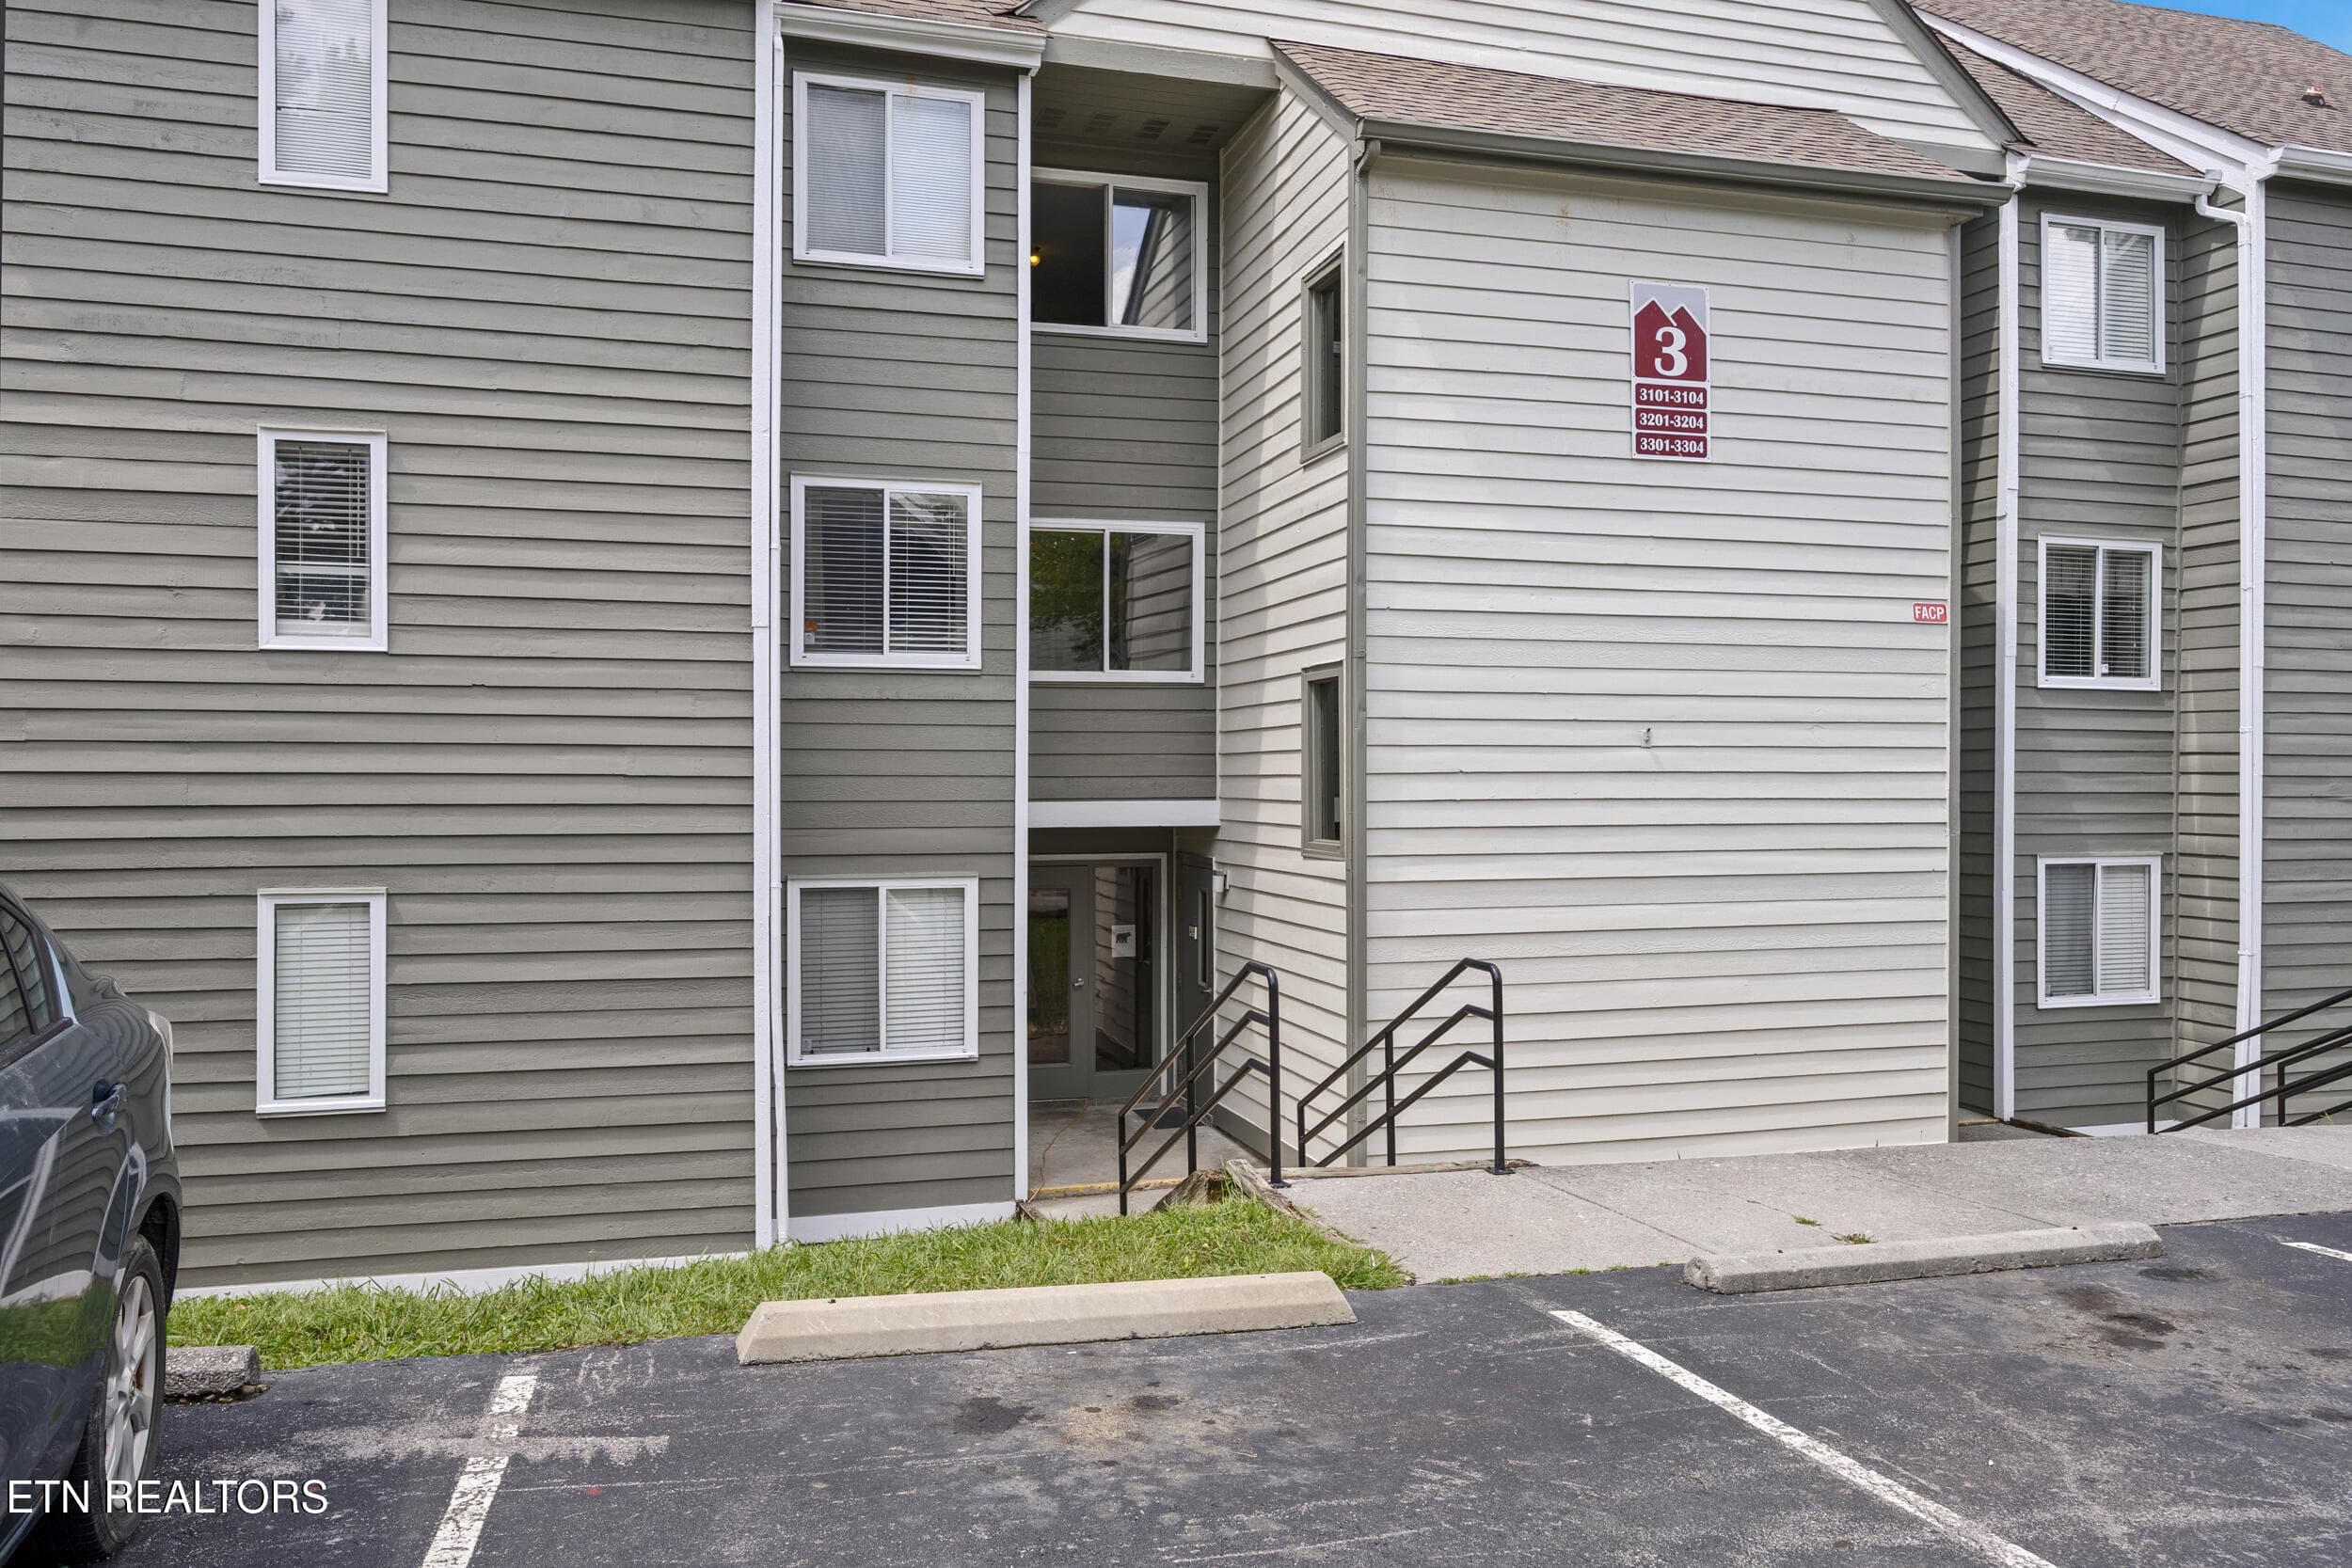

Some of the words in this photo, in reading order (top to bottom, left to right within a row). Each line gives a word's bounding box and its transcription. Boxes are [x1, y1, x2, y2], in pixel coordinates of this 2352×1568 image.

[1655, 326, 1688, 376] 3
[1640, 388, 1704, 404] 3101-3104
[1640, 413, 1704, 429] 3201-3204
[1640, 437, 1704, 453] 3301-3304
[1915, 606, 1945, 620] FACP
